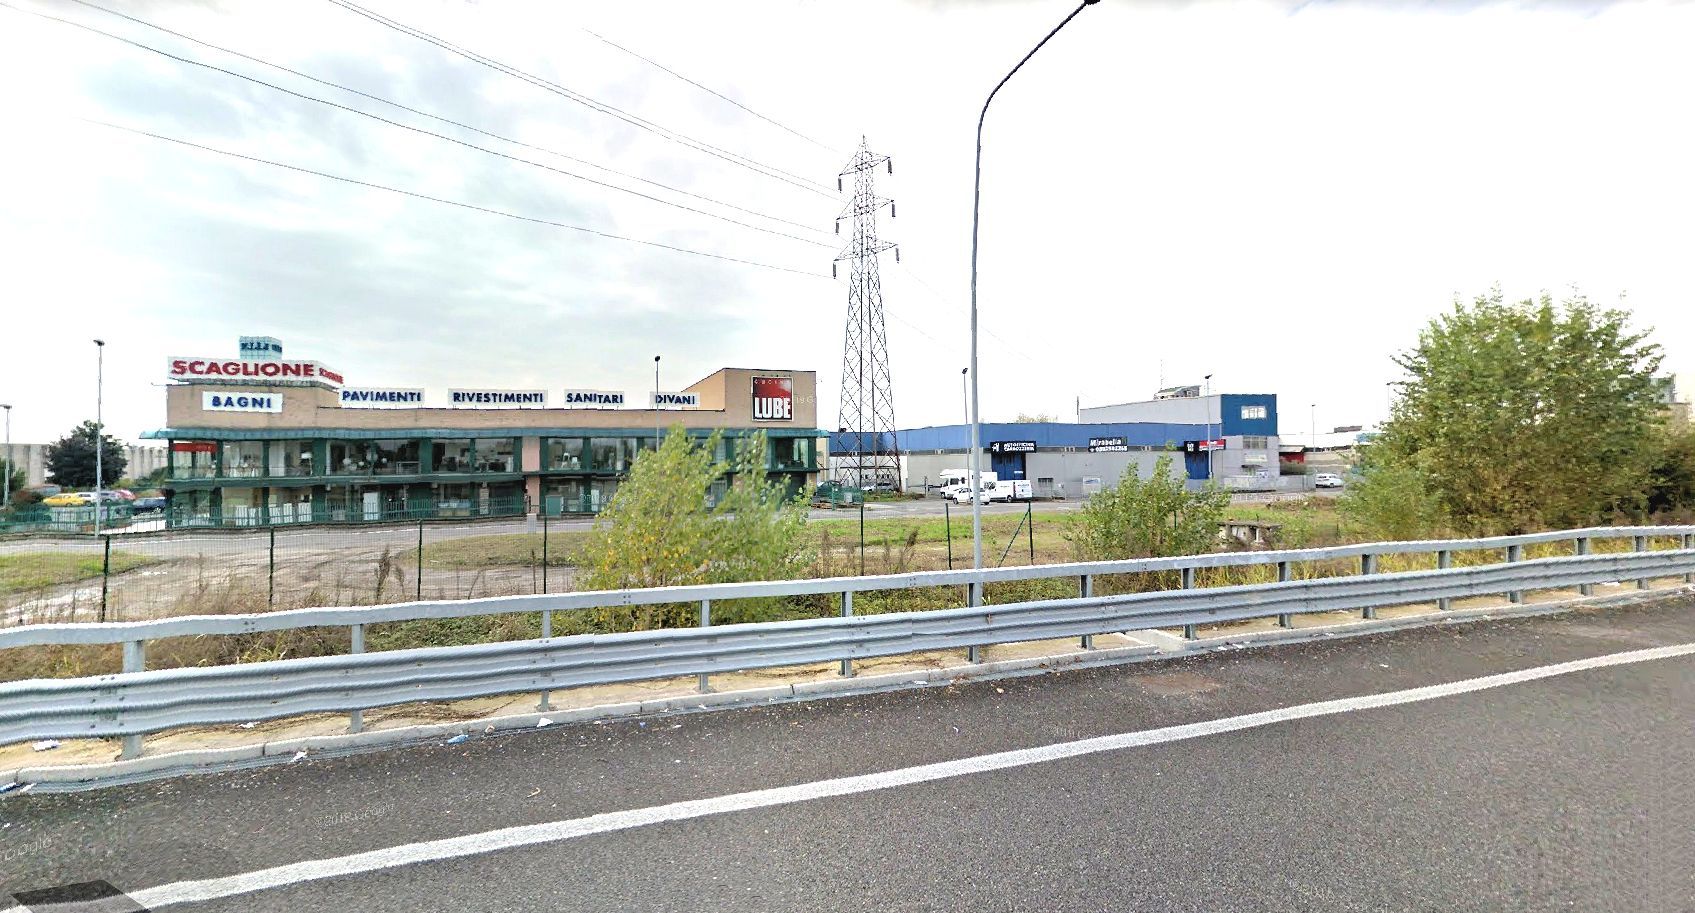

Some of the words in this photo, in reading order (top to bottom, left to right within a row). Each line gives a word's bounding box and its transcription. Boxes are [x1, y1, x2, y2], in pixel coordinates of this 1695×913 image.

[172, 360, 314, 376] SCAGLIONE
[212, 395, 271, 408] BAGNI
[342, 391, 421, 403] PAVIMENTI
[453, 392, 544, 404] RIVESTIMENTI
[566, 392, 624, 404] SANITARI
[655, 394, 694, 405] DIVANI
[754, 397, 791, 418] LUBE
